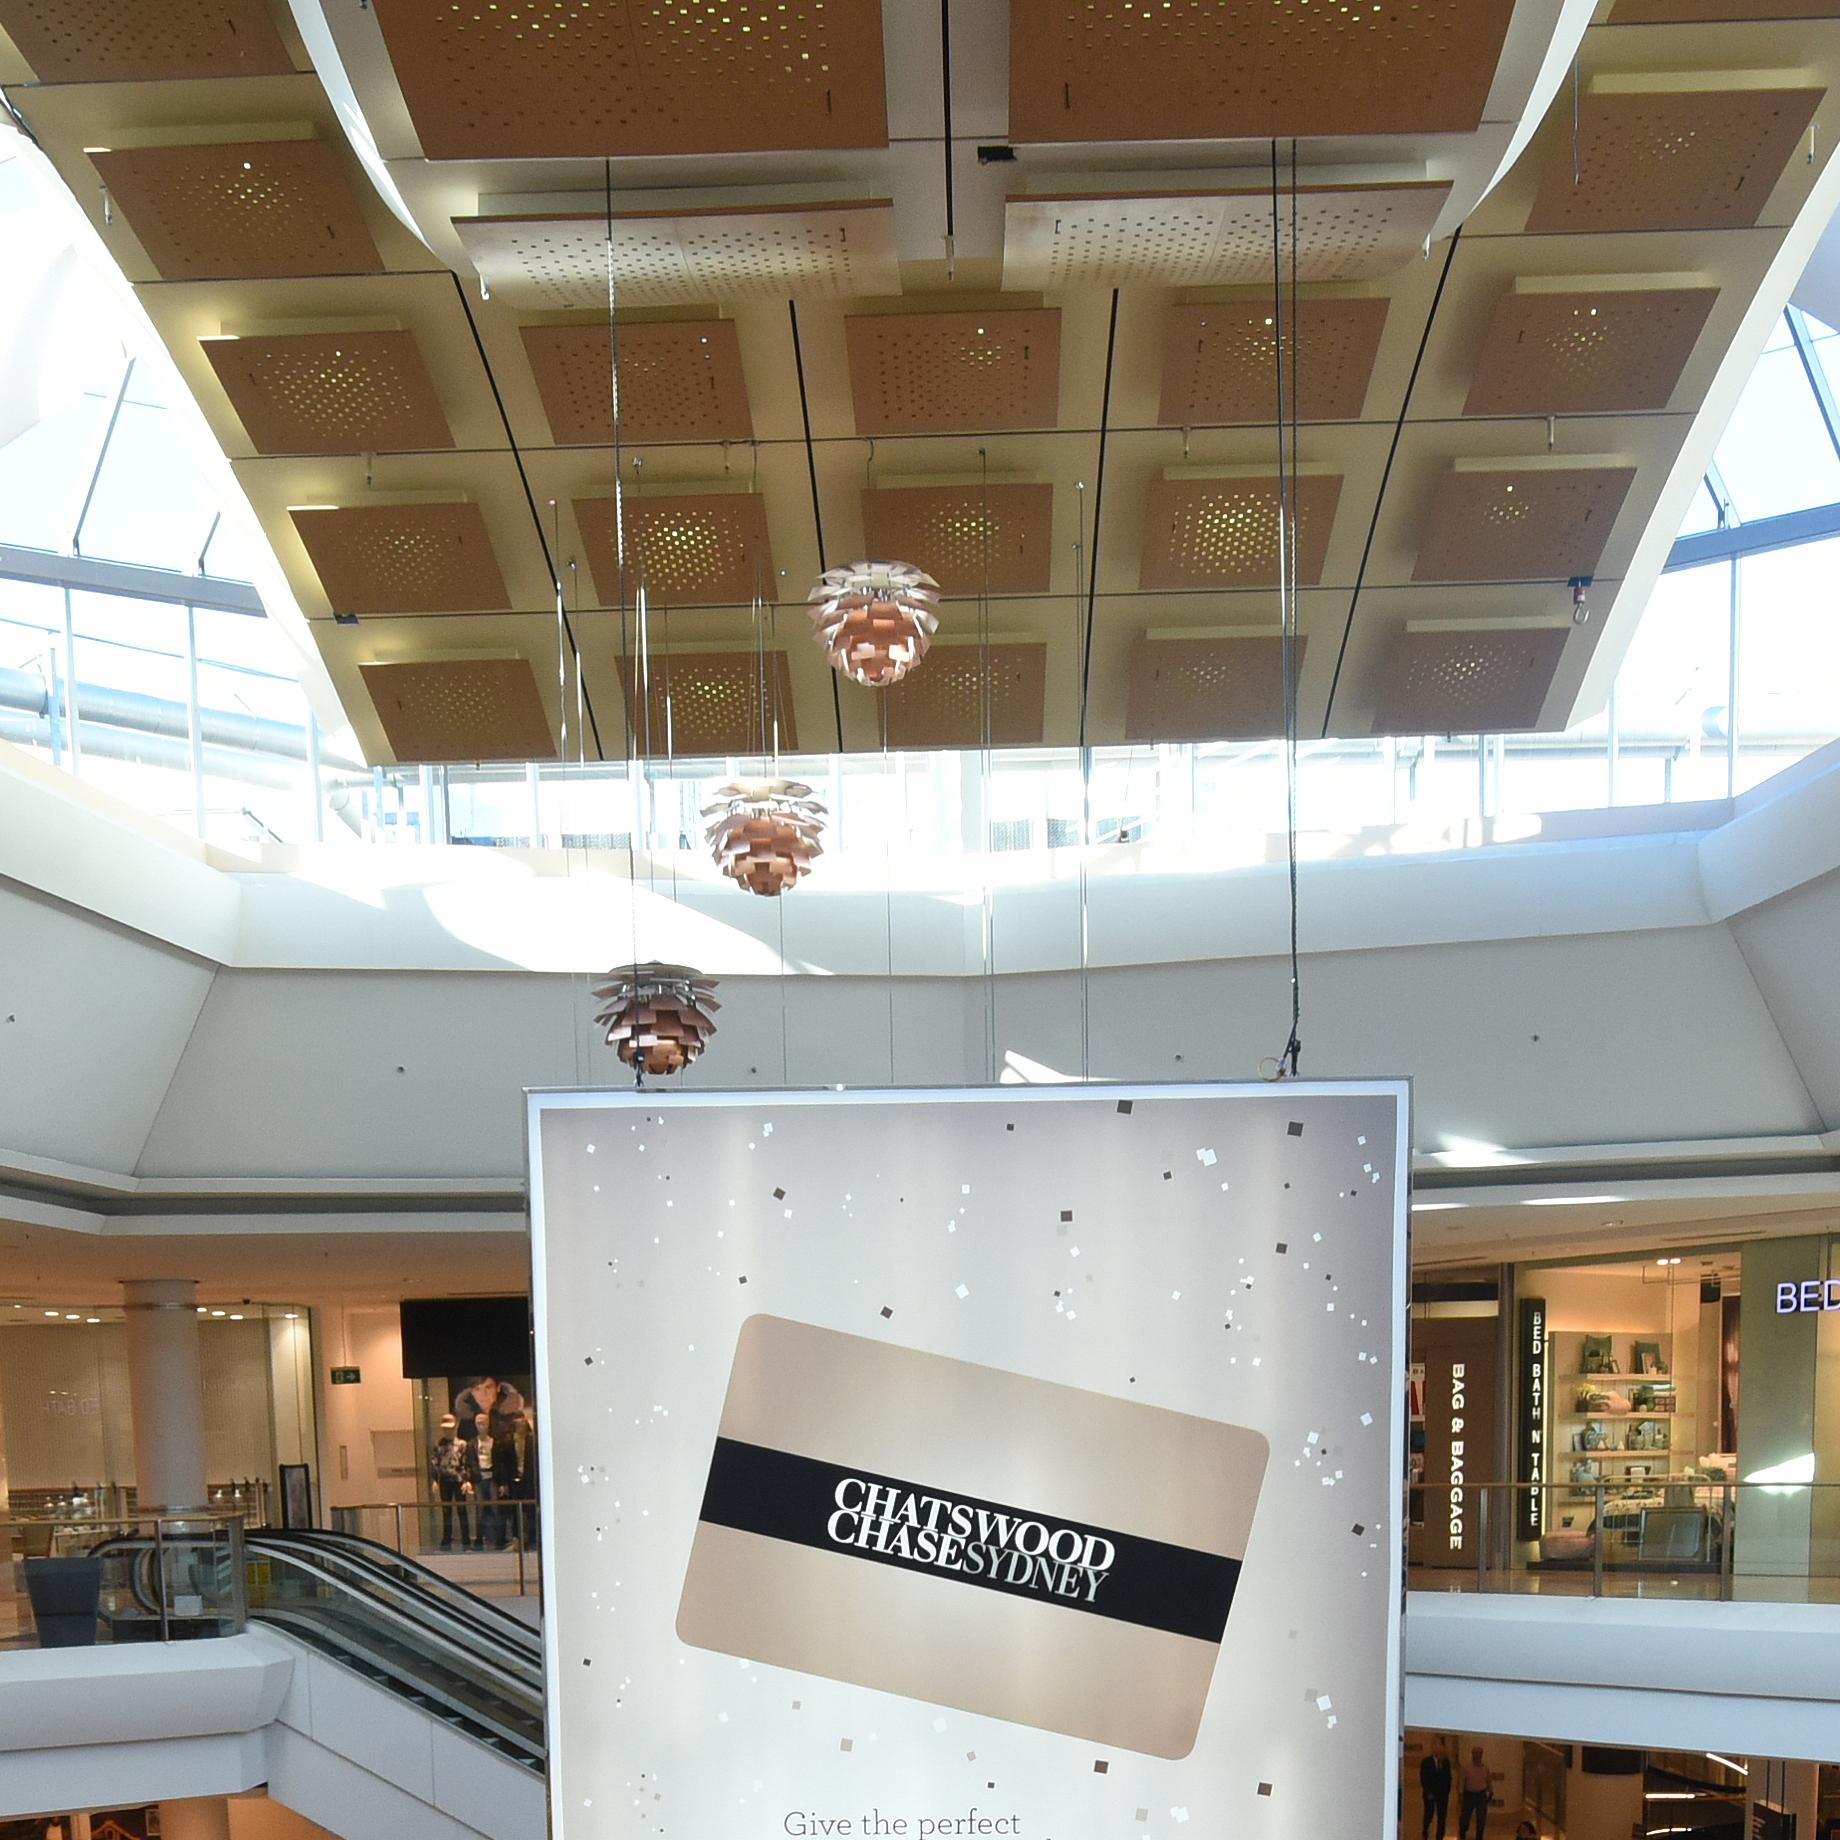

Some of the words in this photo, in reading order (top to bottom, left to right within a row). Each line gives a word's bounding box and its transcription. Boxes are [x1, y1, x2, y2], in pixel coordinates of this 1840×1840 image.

[1531, 1312, 1542, 1355] BED
[1451, 1363, 1465, 1410] BAG
[1531, 1364, 1542, 1420] BATH
[1451, 1417, 1465, 1434] &
[1449, 1441, 1465, 1550] BAGGAGE
[834, 1478, 1116, 1572] CHATSWOOD
[827, 1509, 967, 1571] CHASE
[962, 1541, 1110, 1603] SYDNEY
[783, 1811, 852, 1838] Give
[859, 1810, 910, 1836] the
[917, 1808, 1022, 1840] perfect
